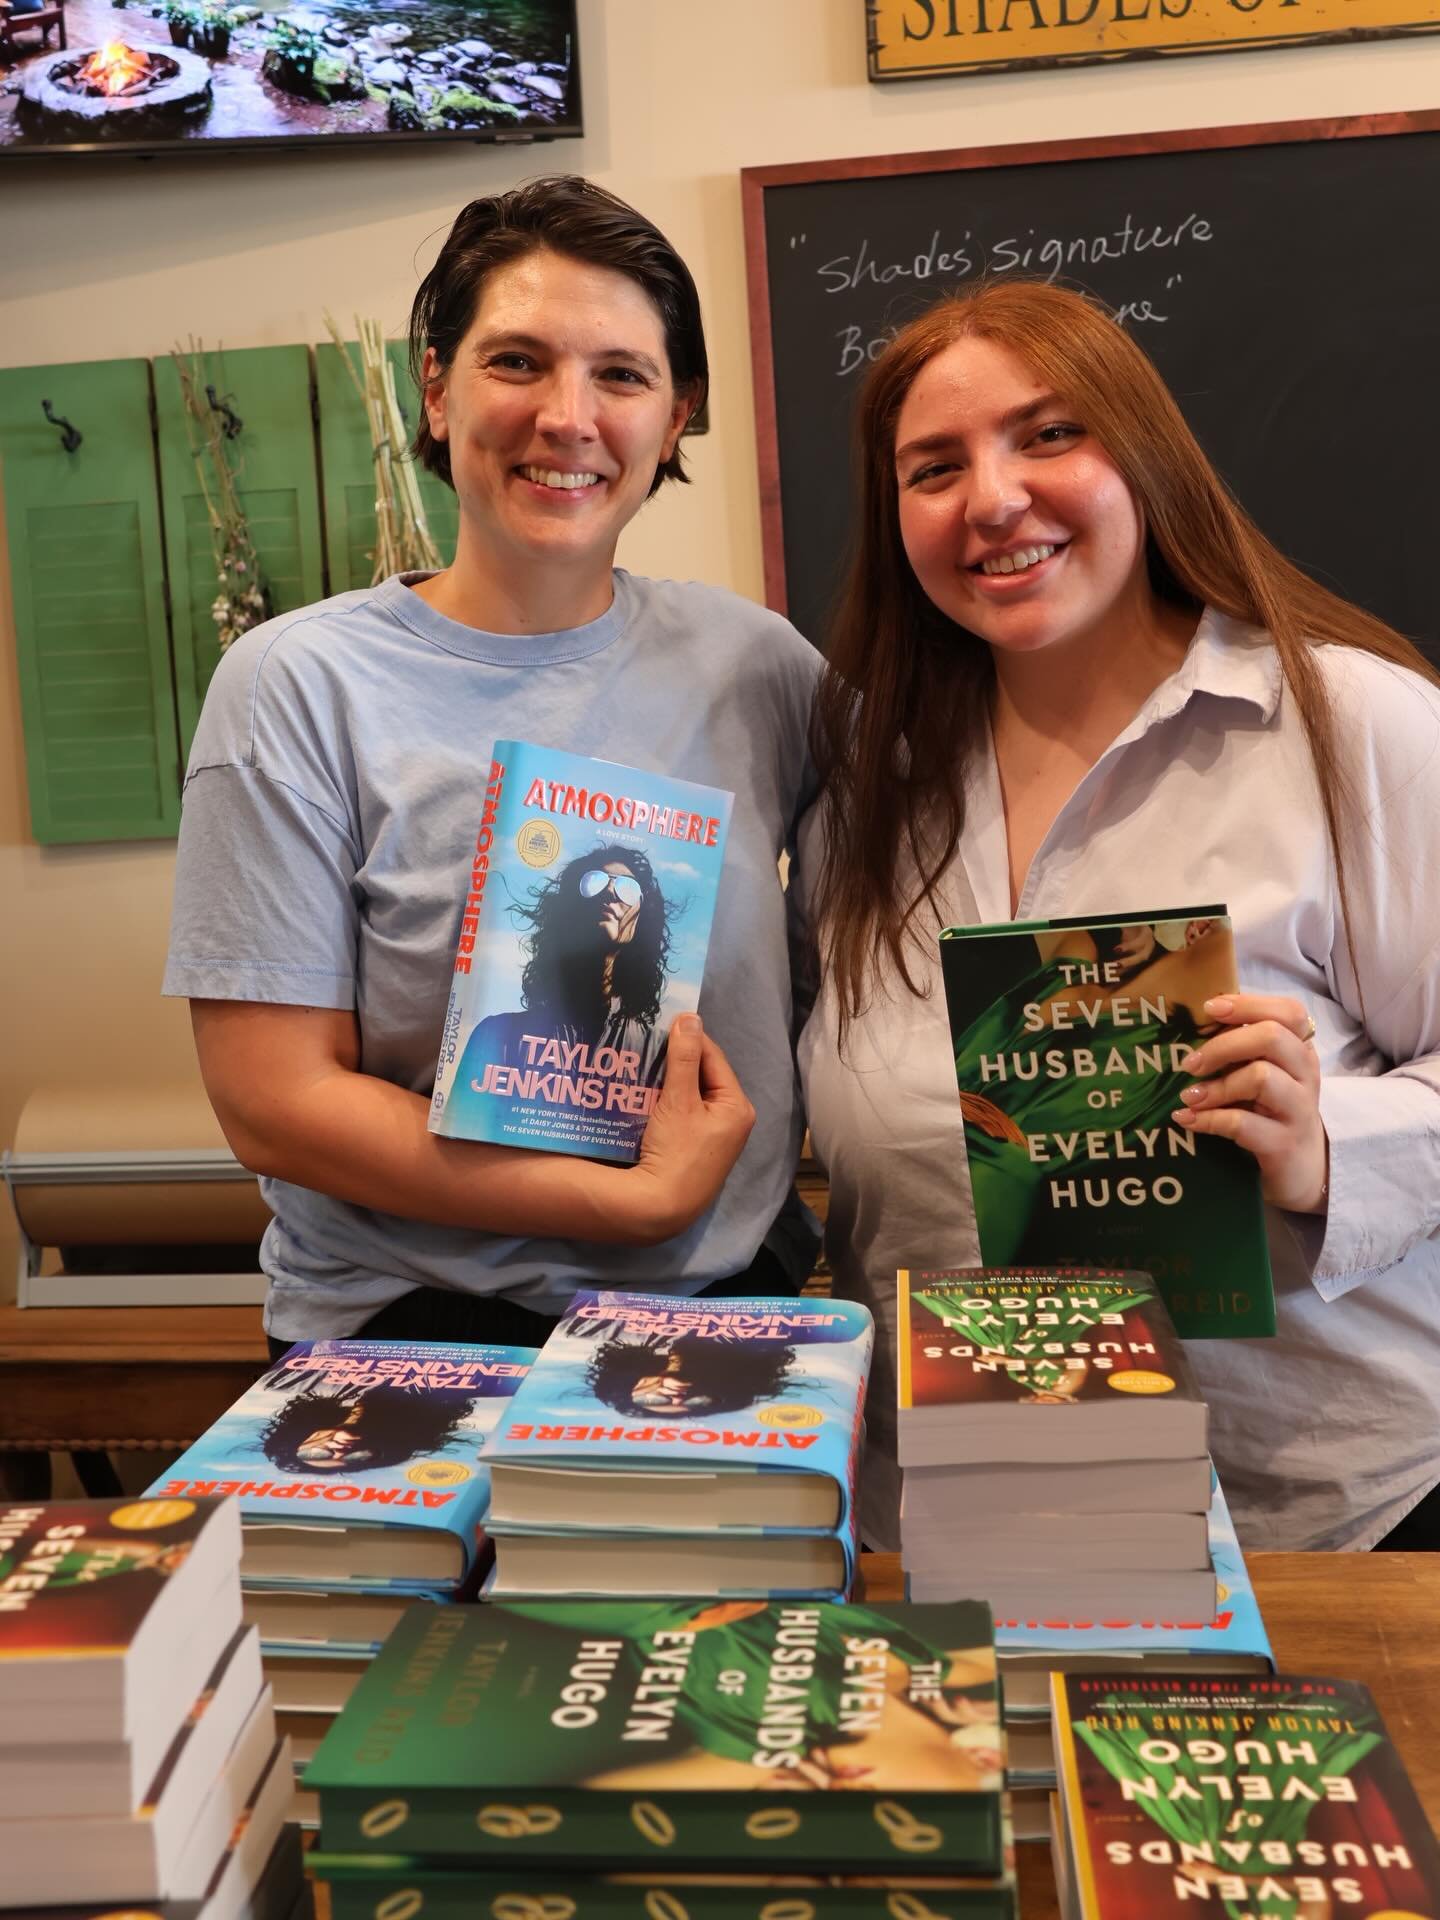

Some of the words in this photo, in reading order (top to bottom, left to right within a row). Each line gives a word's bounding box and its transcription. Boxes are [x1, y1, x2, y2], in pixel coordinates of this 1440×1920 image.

[522, 777, 721, 847] ATMOSPHERE
[454, 759, 506, 975] ATMOSPHERE
[1058, 962, 1121, 985] THE
[1023, 995, 1168, 1032] SEVEN
[446, 1007, 463, 1065] TAYLOR
[521, 1034, 641, 1080] TAYLOR
[980, 1043, 1196, 1082] HUSBAND
[471, 1064, 604, 1110] JENKINS
[1087, 1090, 1122, 1109] OF
[520, 1107, 537, 1115] NEW
[537, 1109, 557, 1118] YORK
[558, 1112, 579, 1121] TIMES
[579, 1115, 612, 1126] bestselling
[611, 1120, 633, 1128] author
[529, 1118, 552, 1127] DAISY
[552, 1122, 575, 1131] JONES
[582, 1125, 596, 1133] THE
[596, 1127, 608, 1135] SIX
[503, 1124, 517, 1133] THE
[517, 1126, 541, 1136] SEVEN
[541, 1130, 580, 1142] HUSBANDS
[580, 1134, 590, 1142] OF
[591, 1136, 616, 1146] EVELYN
[616, 1139, 636, 1148] HUGO
[1026, 1127, 1196, 1162] EVELYN
[1050, 1176, 1184, 1208] HUGO
[975, 1285, 1056, 1295] JENKINS
[1067, 1286, 1134, 1296] TAYLOR
[1171, 1290, 1252, 1314] REID
[576, 1306, 671, 1322] REID
[960, 1296, 1099, 1310] HUGO
[624, 1321, 788, 1339] TAYLOR
[673, 1309, 848, 1327] JENKINS
[942, 1312, 1125, 1327] EVELYN
[1019, 1328, 1049, 1341] of
[923, 1341, 1156, 1358] HUSBANDS
[286, 1356, 371, 1373] REID
[972, 1357, 1114, 1372] SEVEN
[324, 1371, 479, 1389] TAYLOR
[505, 1423, 819, 1450] ATMOSPHERE
[158, 1480, 457, 1509] ATMOSPHERE
[551, 1640, 623, 1729] HUGO
[621, 1630, 697, 1741] EVELYN
[716, 1669, 747, 1696] OF
[752, 1609, 821, 1769] HUSBANDS
[837, 1637, 890, 1732] SEVEN
[910, 1660, 942, 1703] THE
[1086, 1715, 1140, 1731] REID
[1153, 1715, 1255, 1732] JENKINS
[1268, 1714, 1356, 1734] TAYLOR
[1138, 1738, 1318, 1765] HUGO
[1120, 1774, 1358, 1802] EVELYN
[1225, 1809, 1263, 1832] of
[1105, 1840, 1413, 1869] HUSBANDS
[1173, 1876, 1363, 1903] SEVEN
